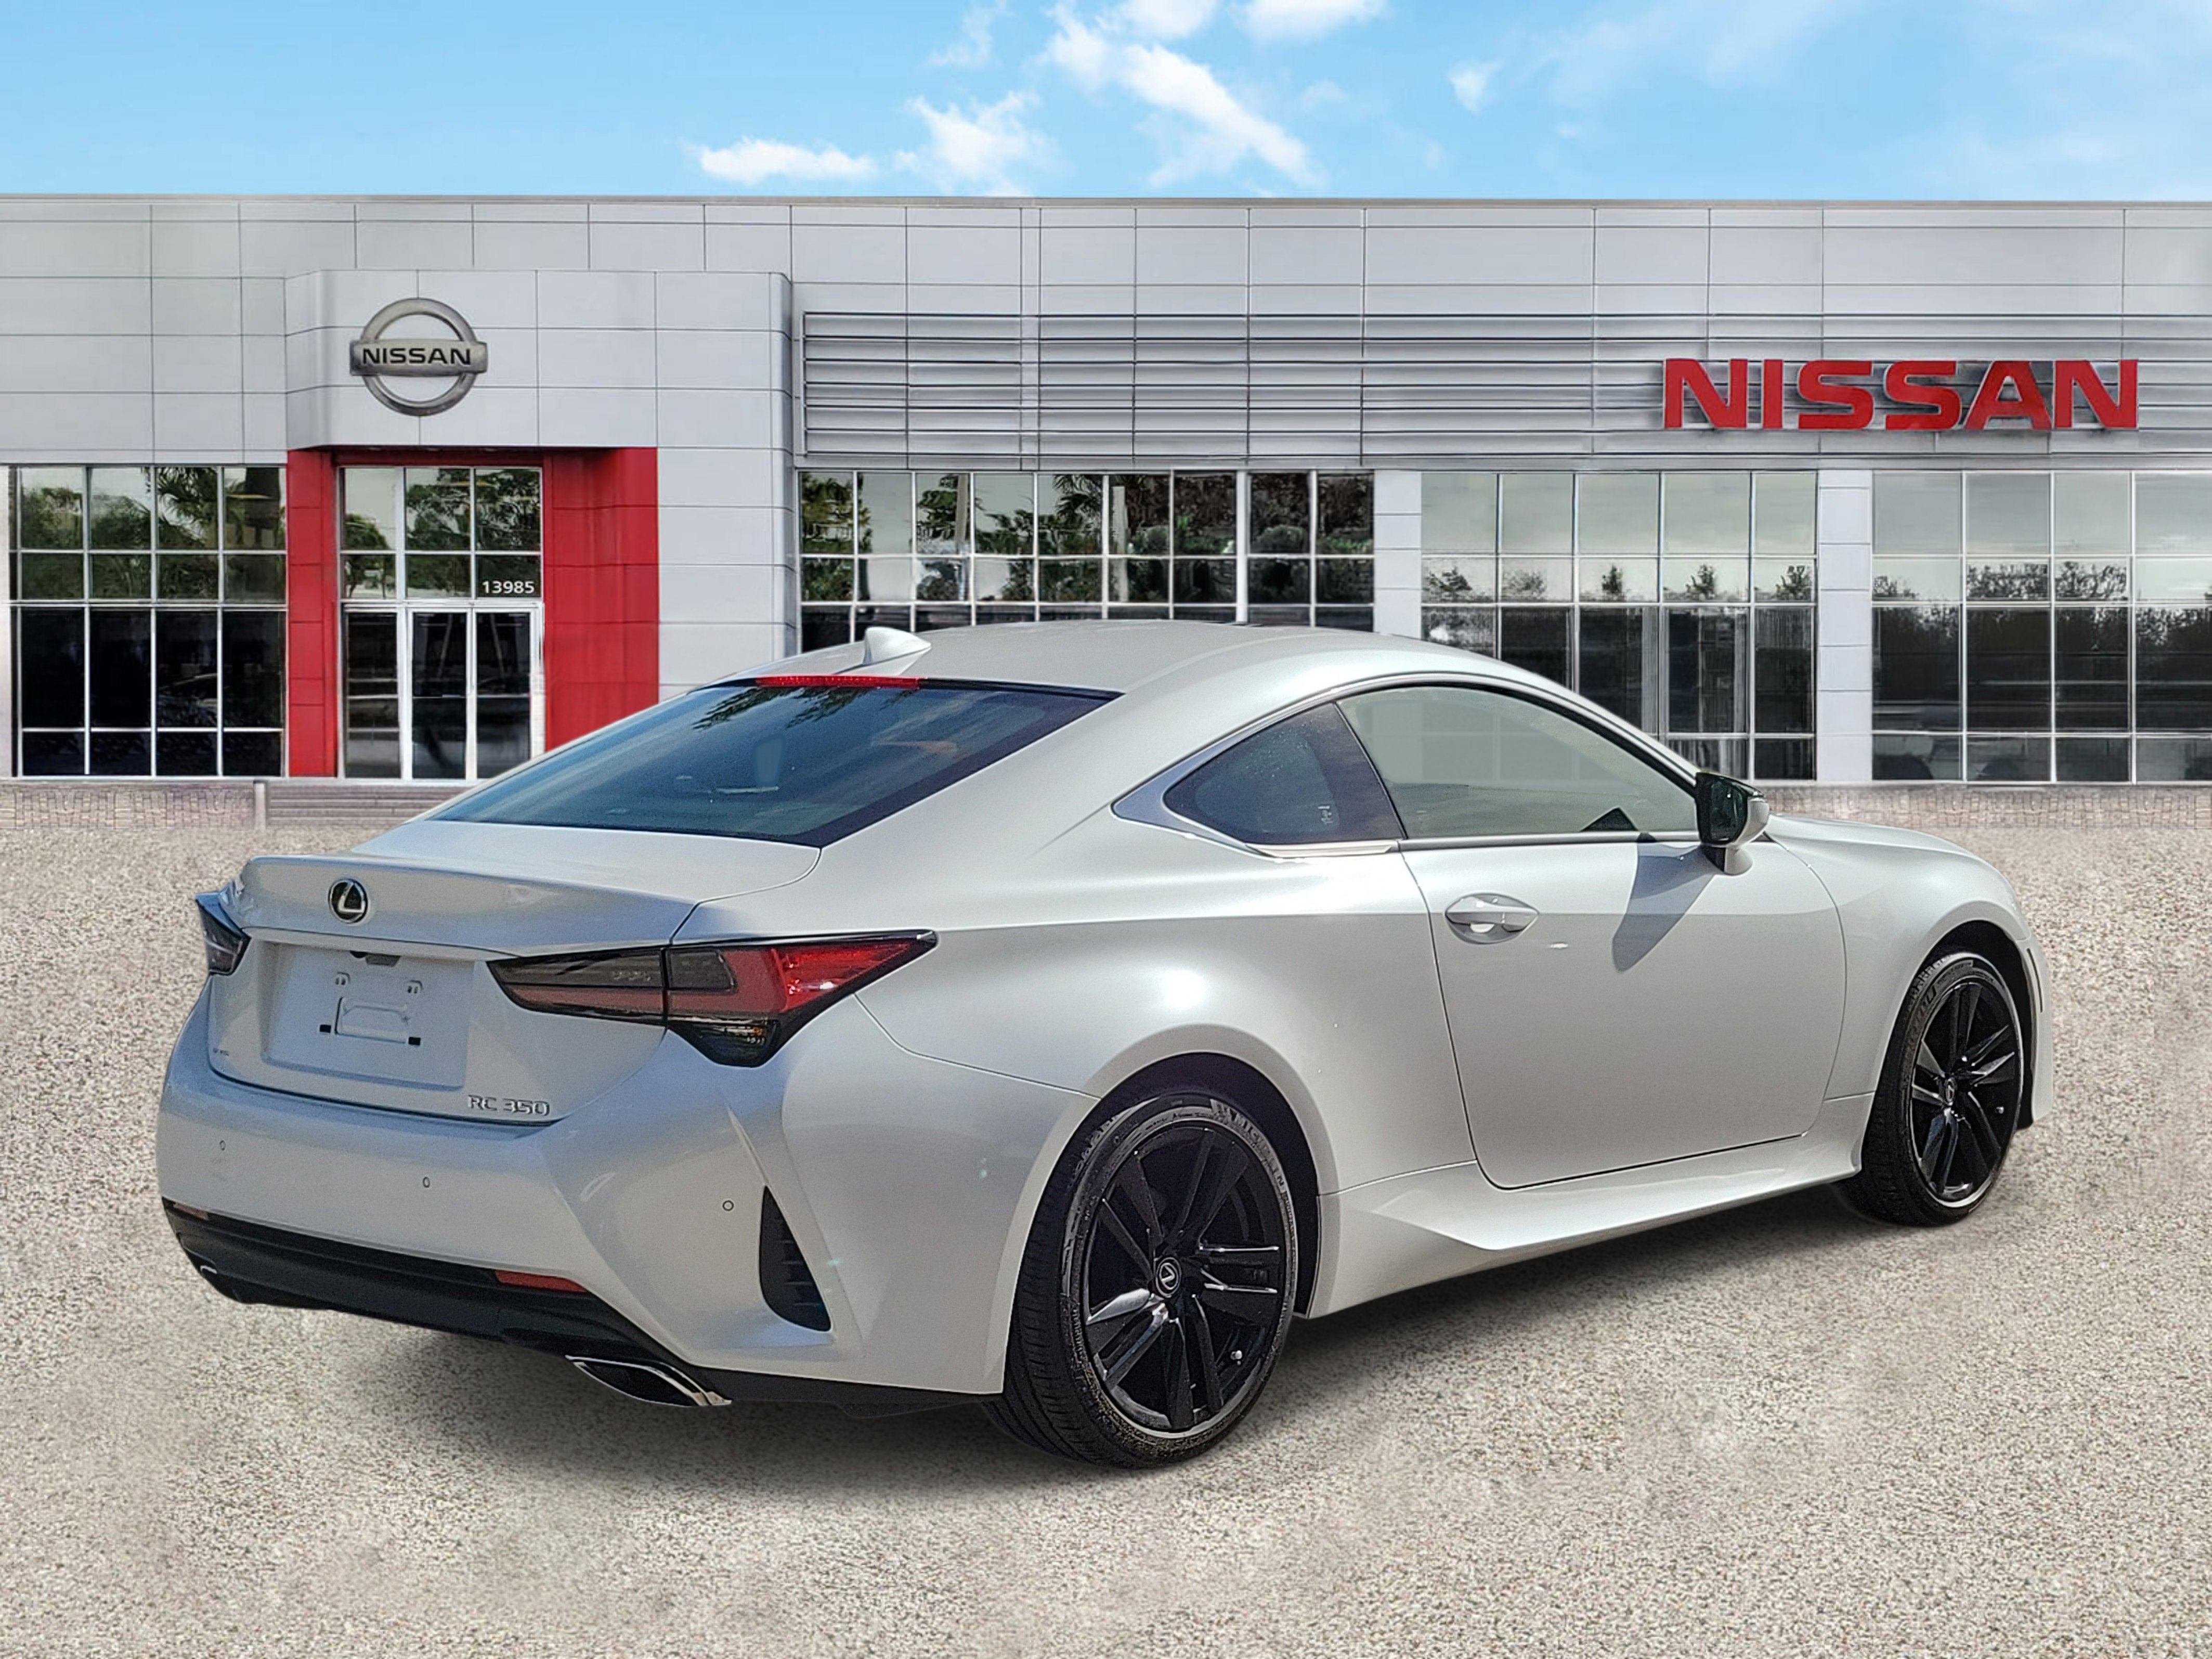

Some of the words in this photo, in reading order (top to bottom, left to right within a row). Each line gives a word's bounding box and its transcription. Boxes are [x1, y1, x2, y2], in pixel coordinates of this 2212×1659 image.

[363, 348, 471, 366] NISSAN
[1664, 359, 2138, 430] NISSAN
[482, 580, 535, 594] 13985
[469, 1094, 497, 1111] RC
[502, 1098, 550, 1116] 350
